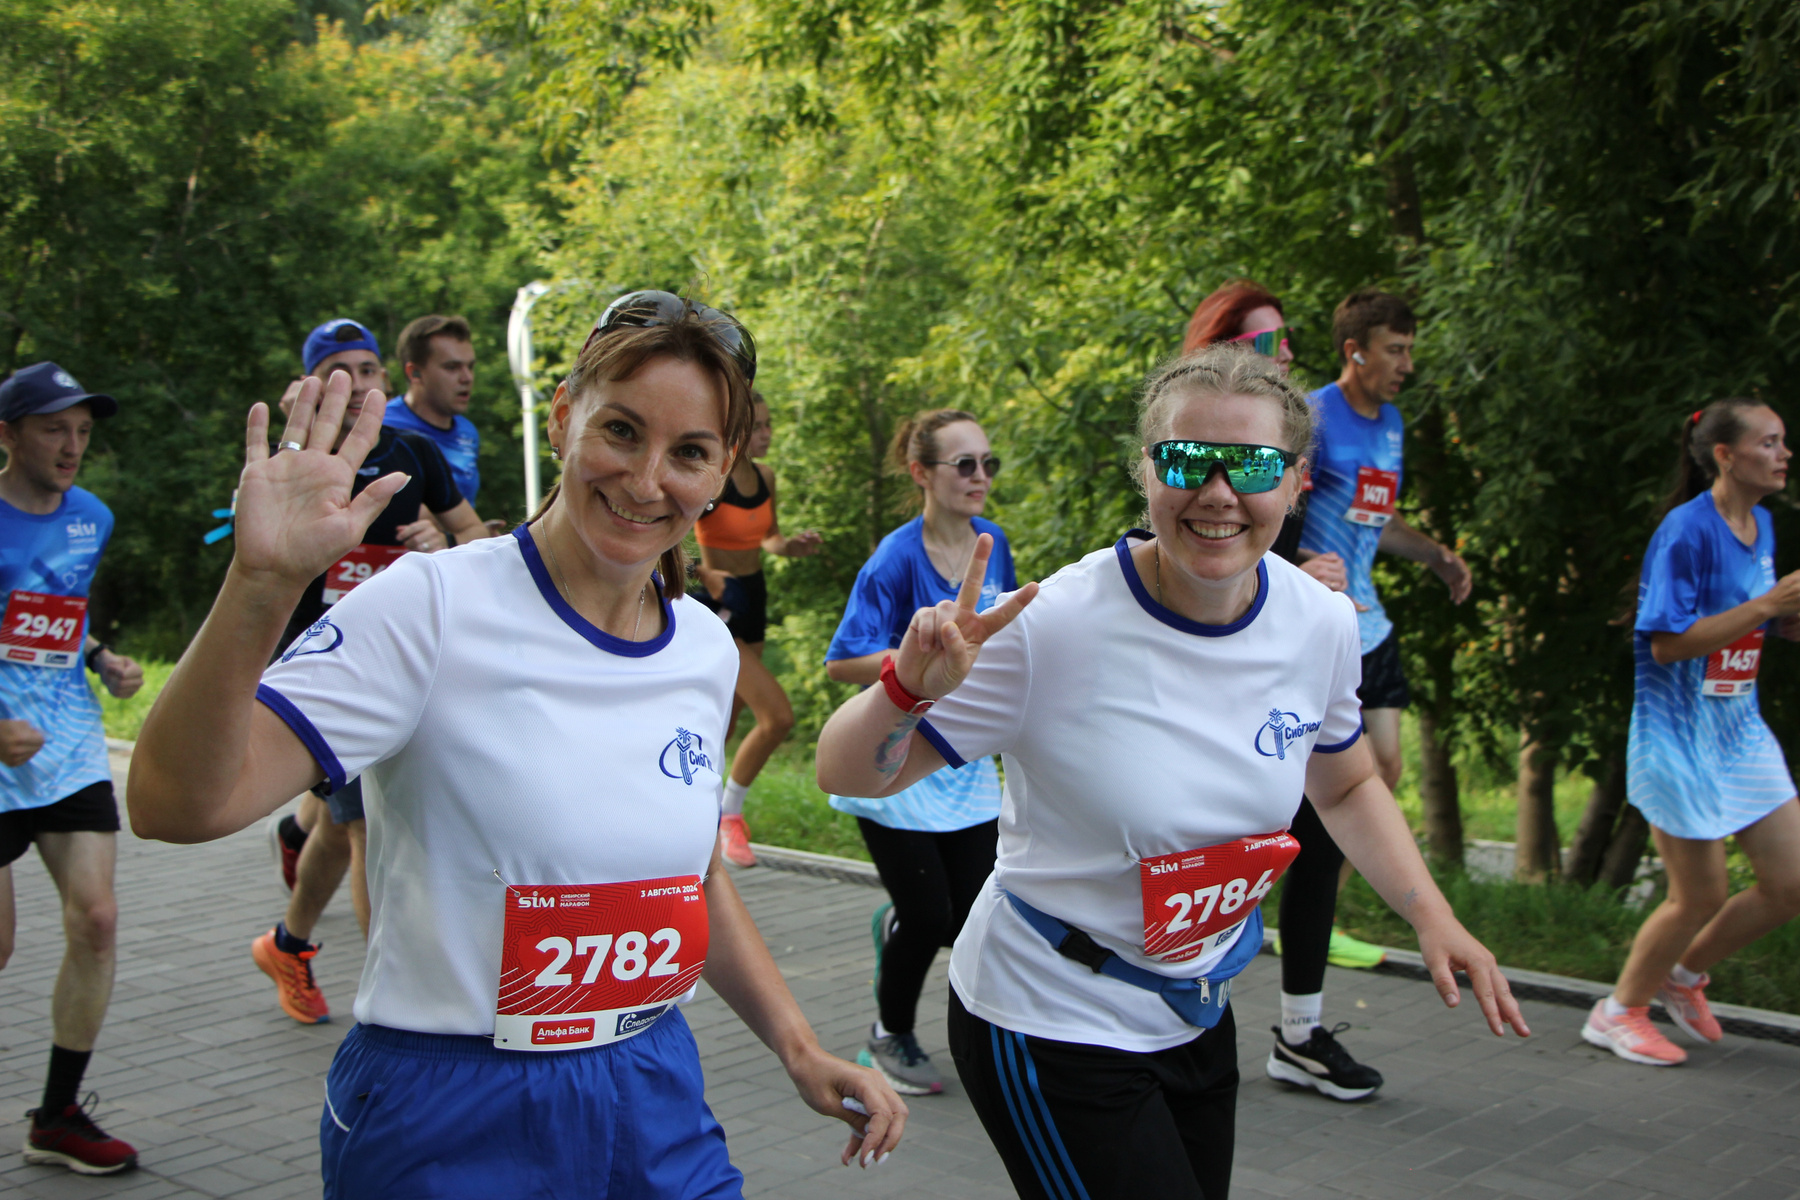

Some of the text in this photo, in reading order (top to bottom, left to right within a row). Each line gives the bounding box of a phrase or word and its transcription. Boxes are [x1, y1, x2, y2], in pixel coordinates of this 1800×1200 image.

[1363, 483, 1389, 506] 1471
[337, 561, 387, 583] 29
[12, 612, 78, 641] 2947
[1720, 648, 1761, 671] 1457
[1250, 837, 1277, 850] АВГУСТА
[640, 885, 698, 898] 3 АВГУСТА 2024
[1164, 869, 1274, 934] 2784
[535, 927, 681, 987] 2782
[536, 1025, 590, 1038] Альфа Банк
